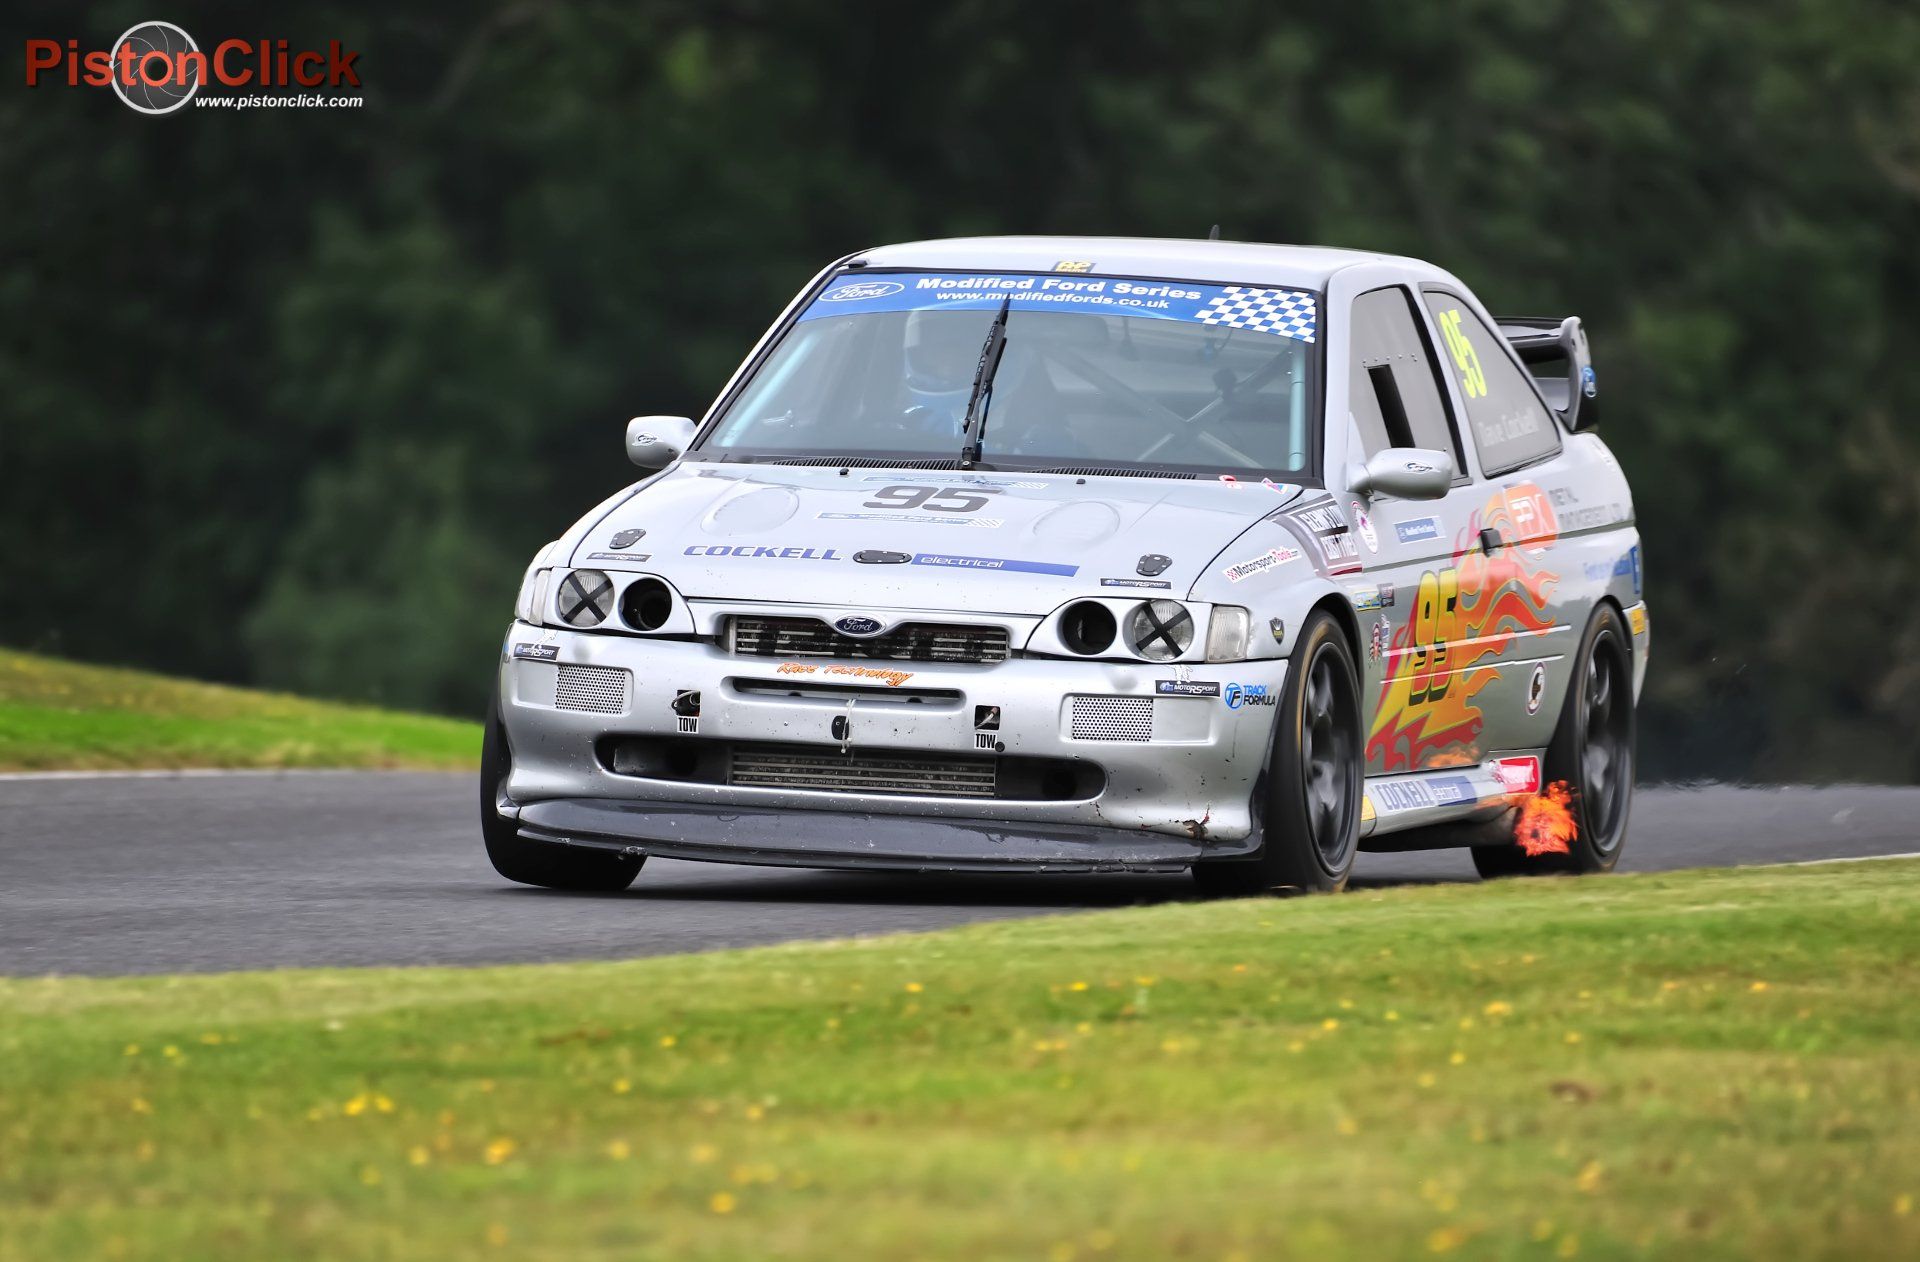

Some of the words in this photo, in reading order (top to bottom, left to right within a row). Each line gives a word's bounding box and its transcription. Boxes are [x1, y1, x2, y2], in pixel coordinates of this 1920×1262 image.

[832, 284, 890, 300] Ford
[916, 278, 1034, 290] Modified
[1042, 279, 1106, 292] Ford
[1113, 283, 1201, 299] Series
[936, 291, 1170, 309] www.modifiedfords.co.uk
[1439, 309, 1487, 398] 95
[863, 485, 1002, 512] 95
[683, 545, 842, 561] COCKELL
[920, 556, 1004, 568] electrical
[844, 618, 874, 631] Ford
[1410, 568, 1457, 706] 95
[777, 662, 819, 674] Race
[824, 664, 914, 687] Technology
[1174, 684, 1217, 694] MOTORSPORT
[1243, 684, 1267, 695] TRACK
[1243, 694, 1276, 706] FORMULA
[678, 717, 698, 733] TOW
[975, 733, 997, 749] TOW
[1375, 780, 1435, 810] COCKELL
